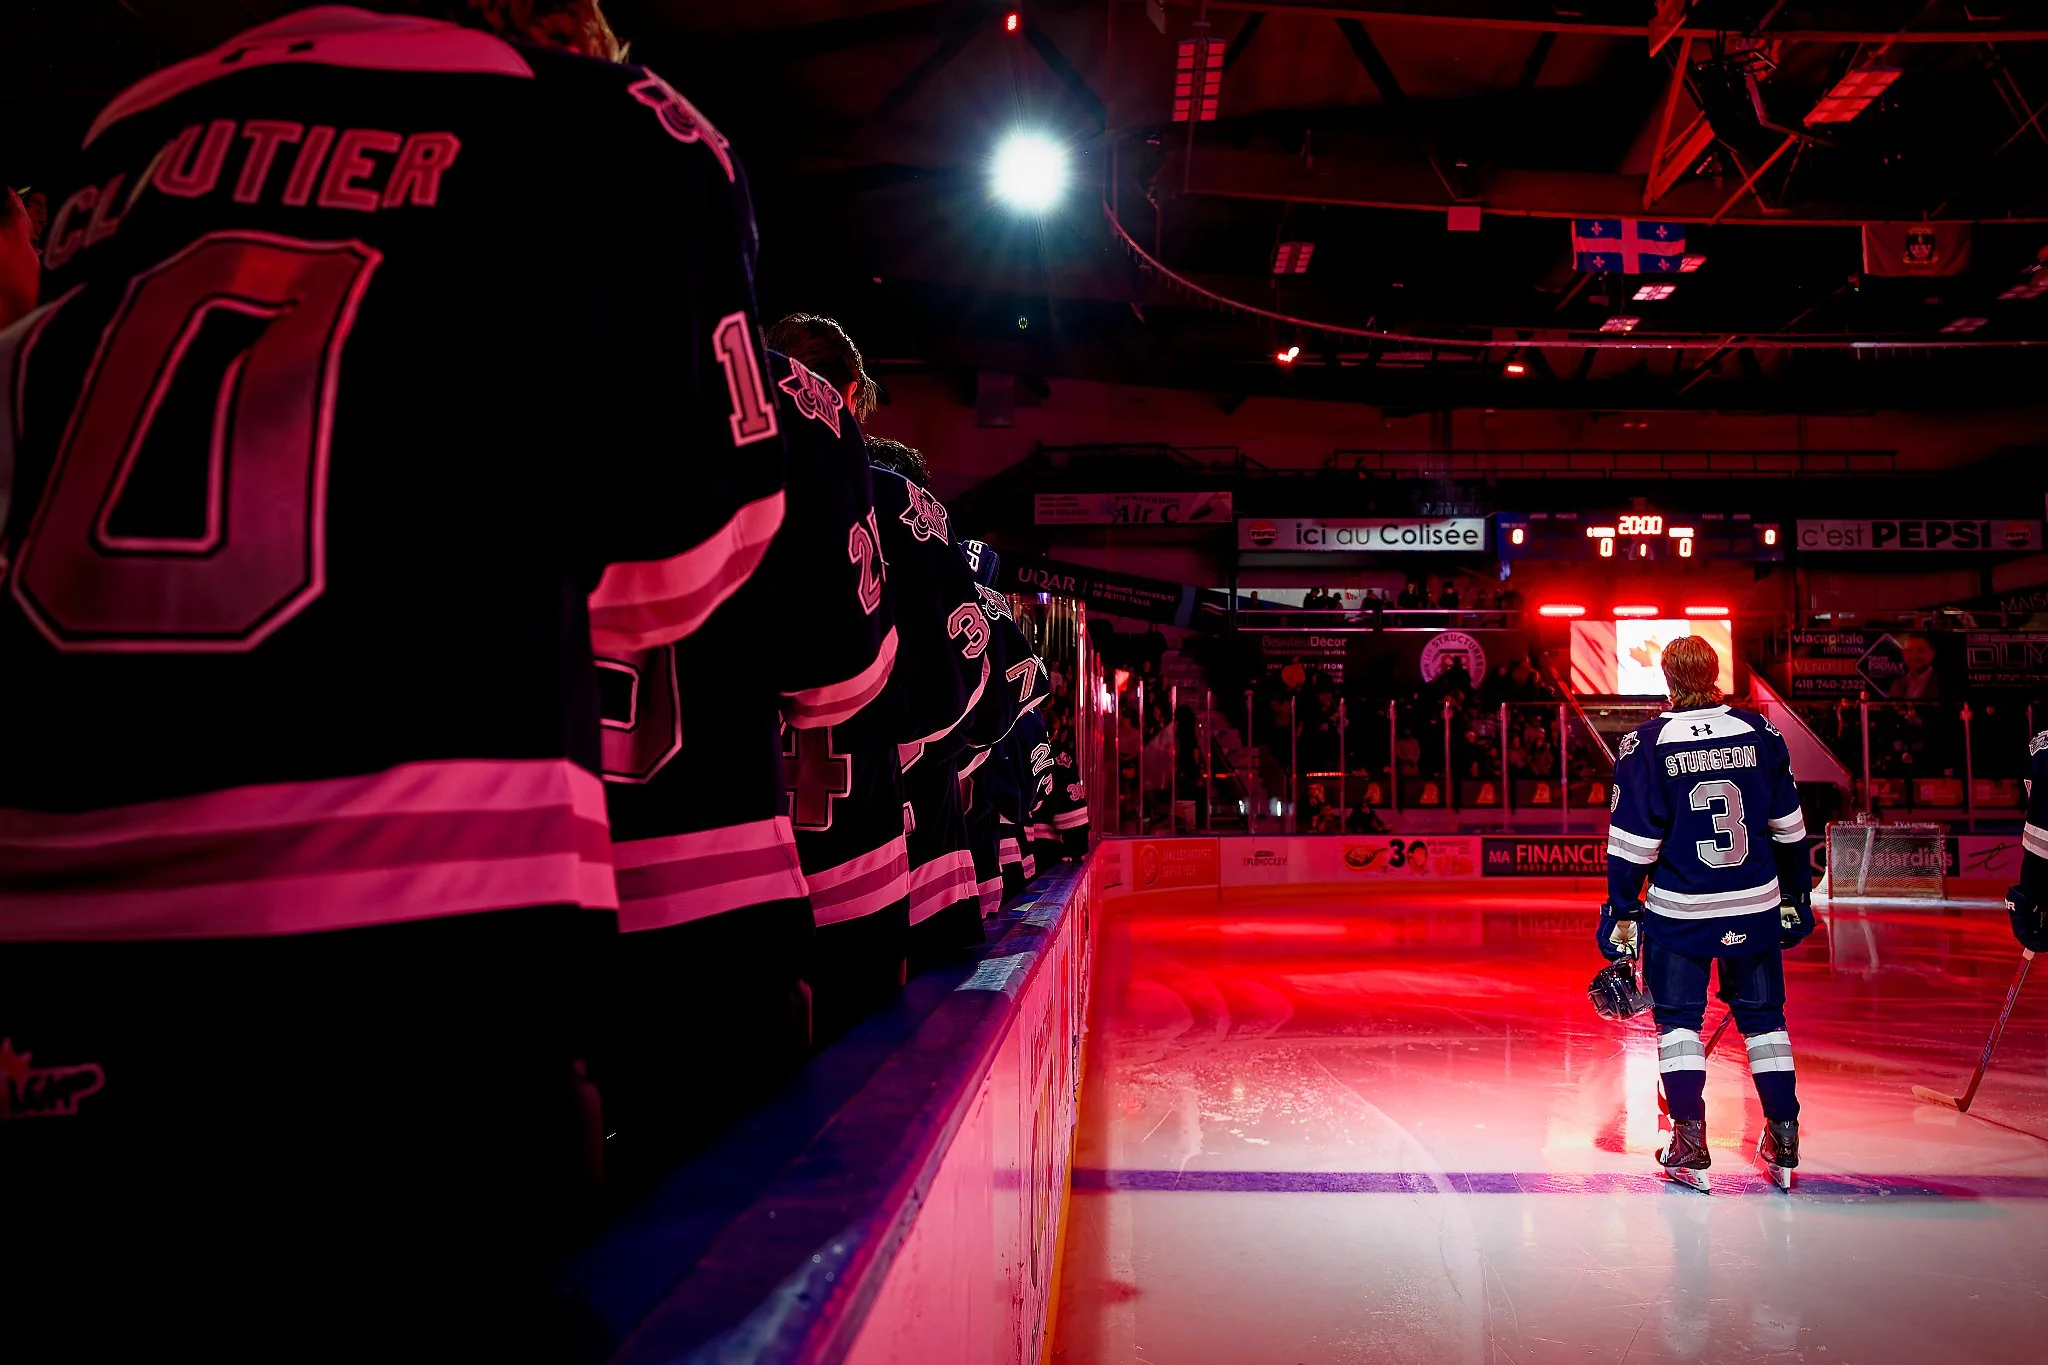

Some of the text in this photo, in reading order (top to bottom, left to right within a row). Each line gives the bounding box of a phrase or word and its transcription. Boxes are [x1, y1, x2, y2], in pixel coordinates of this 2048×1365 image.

[43, 118, 463, 271] CLUTIER
[0, 228, 384, 655] 0
[1112, 504, 1154, 523] Air
[1618, 515, 1662, 535] 20:00
[1296, 522, 1479, 545] ici au Colisée
[1600, 537, 1613, 557] 0
[1679, 537, 1692, 557] 0
[1801, 521, 1992, 548] c'est PEPSI
[848, 506, 889, 615] 2
[1017, 567, 1076, 592] UQAR
[1999, 591, 2048, 612] MAIS
[947, 602, 990, 659] 3
[1006, 657, 1038, 702] 7
[1031, 743, 1055, 776] 2
[1665, 746, 1756, 776] STURGEON
[1689, 779, 1749, 868] 3
[1488, 850, 1511, 863] MA
